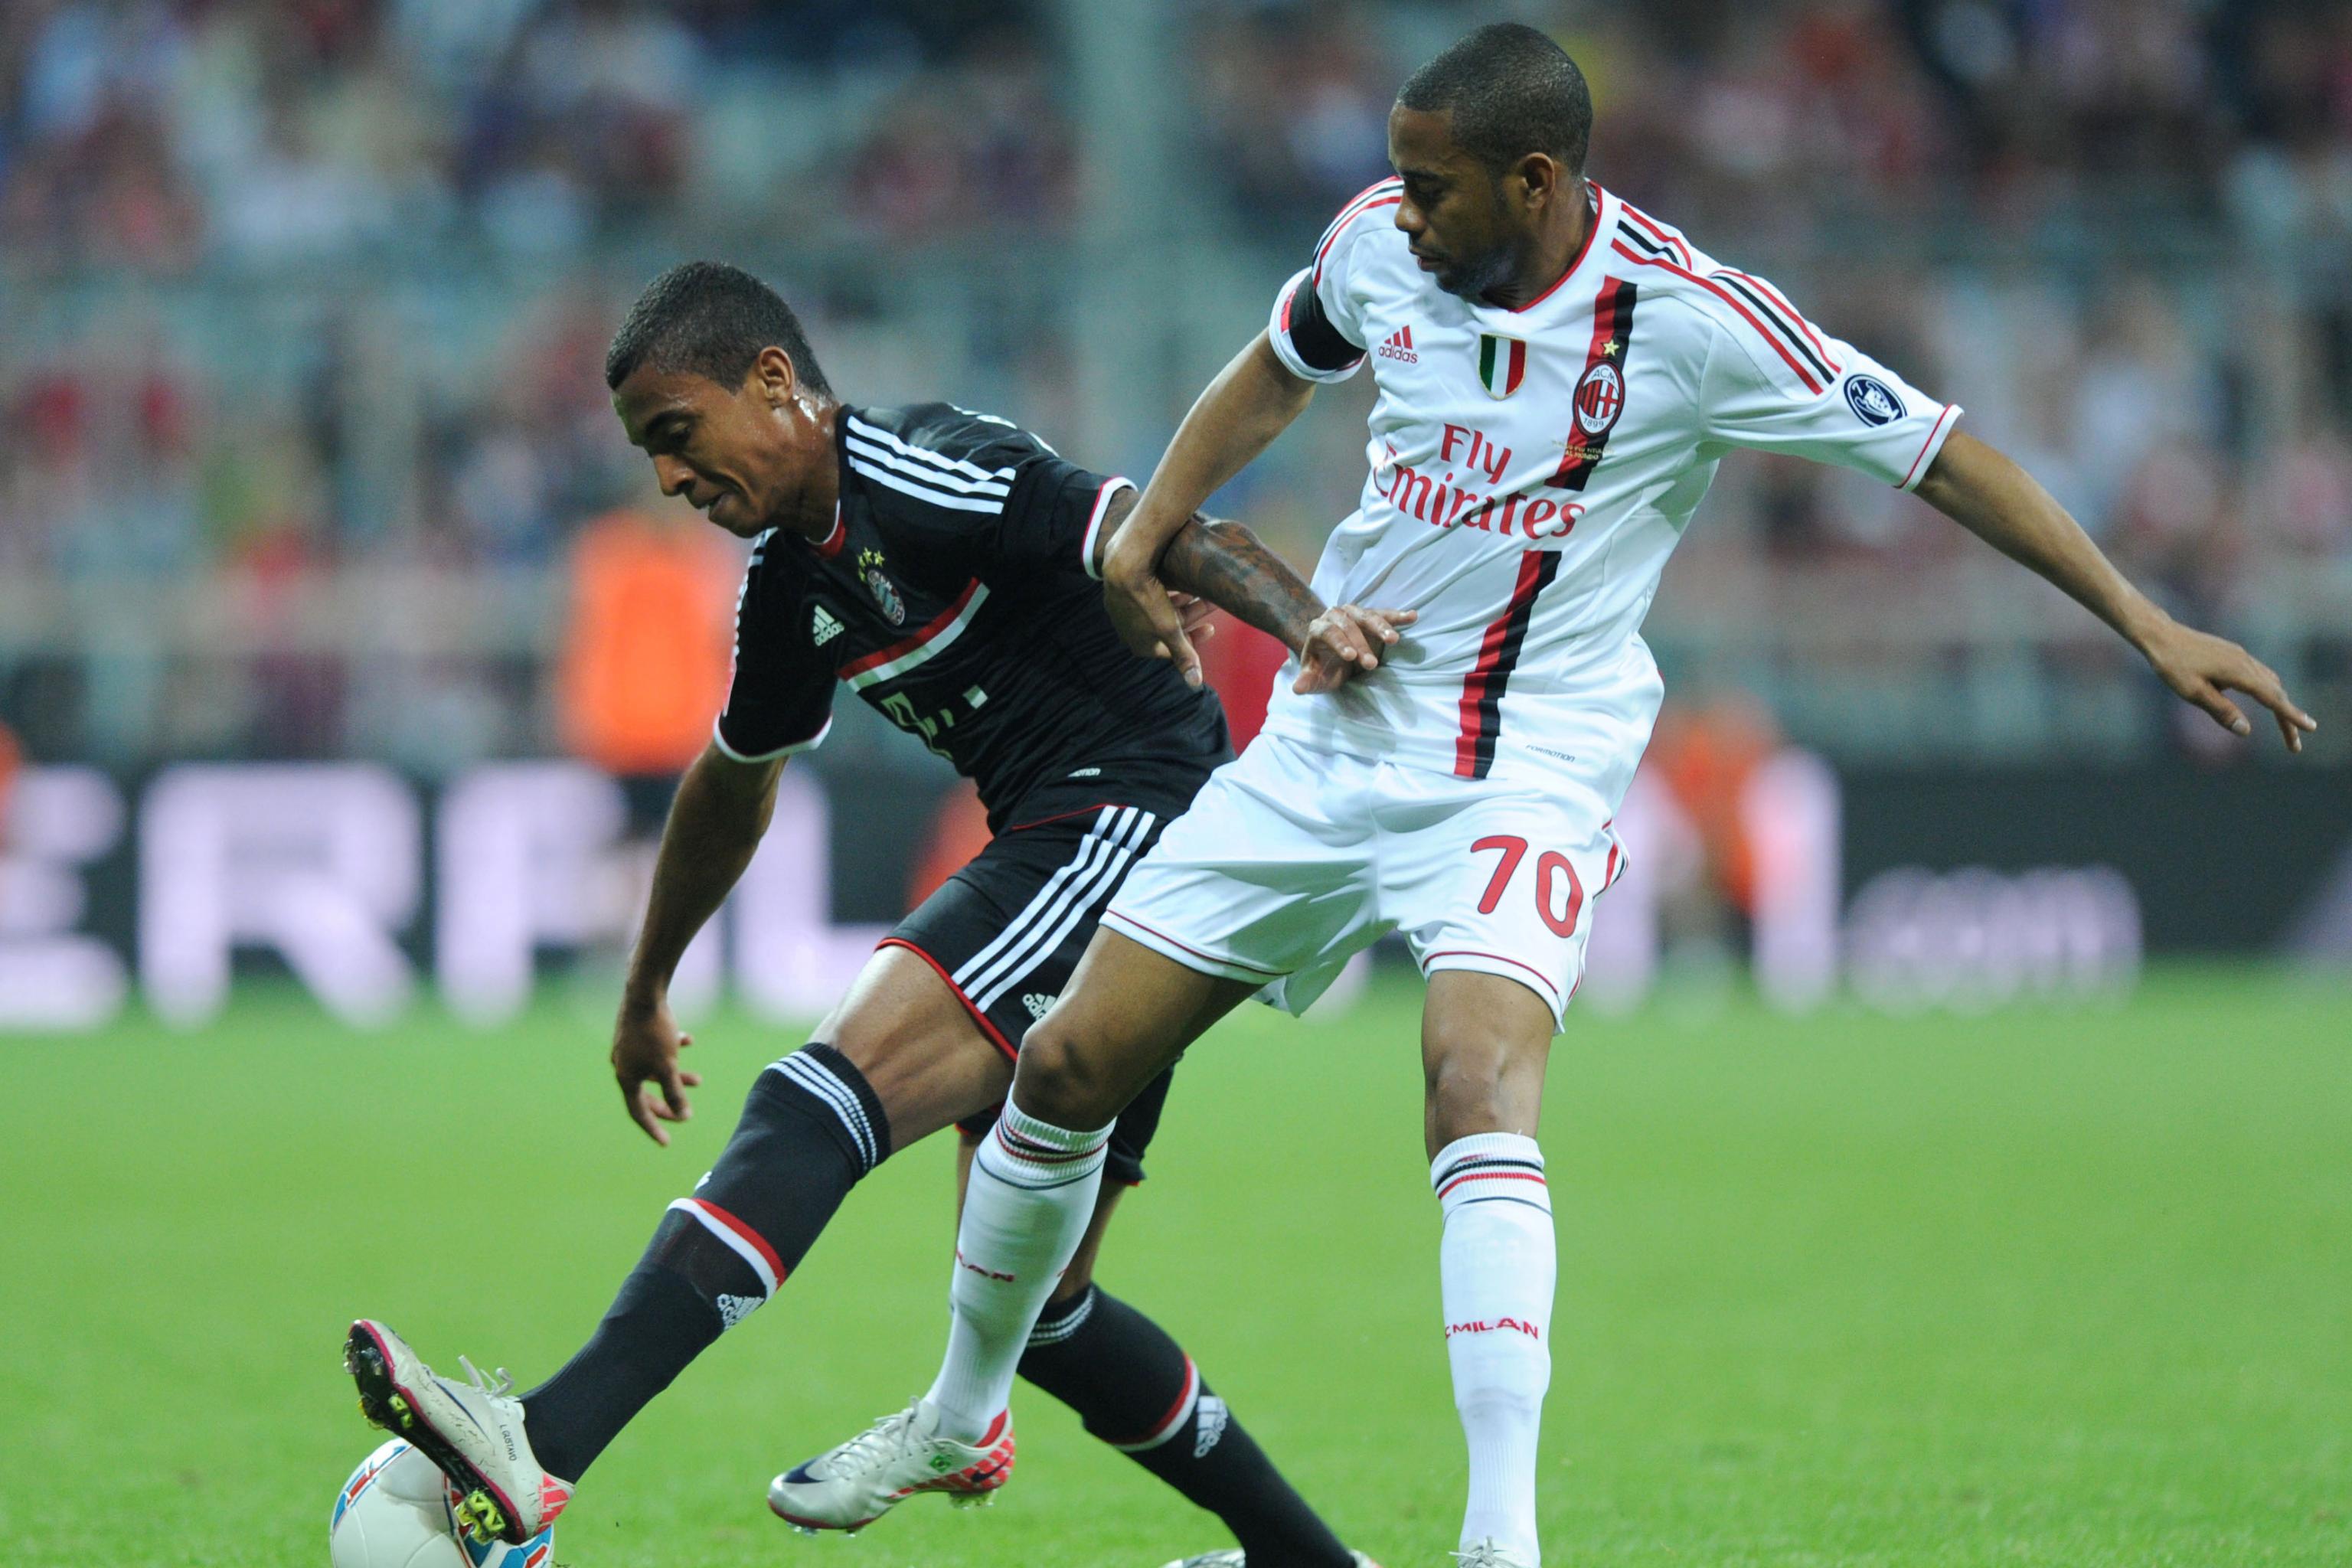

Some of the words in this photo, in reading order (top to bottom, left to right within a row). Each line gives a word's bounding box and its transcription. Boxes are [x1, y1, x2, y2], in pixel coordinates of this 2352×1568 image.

[1378, 344, 1419, 364] adidas
[1591, 368, 1616, 384] ACM
[1583, 417, 1604, 428] 1899
[1441, 423, 1512, 485] Fly
[1470, 834, 1583, 938] 70
